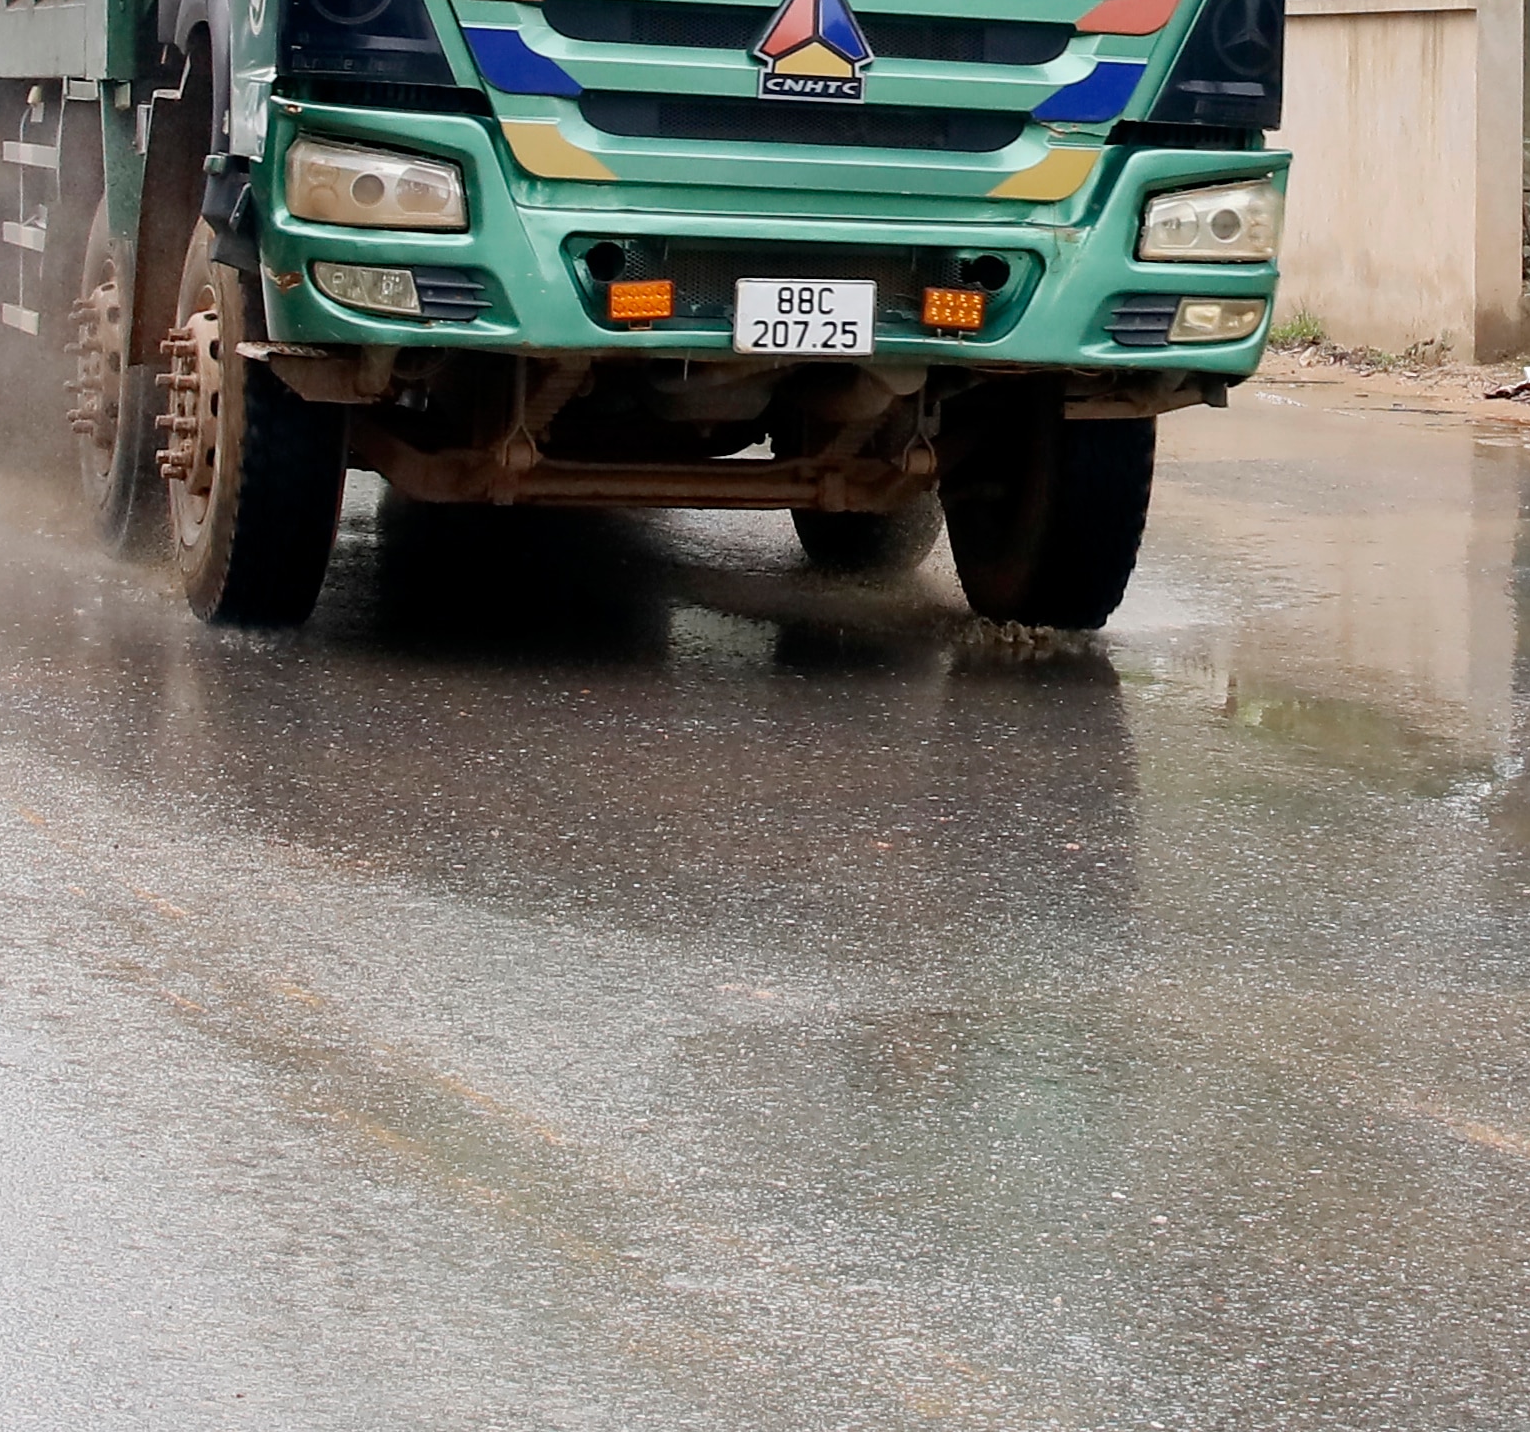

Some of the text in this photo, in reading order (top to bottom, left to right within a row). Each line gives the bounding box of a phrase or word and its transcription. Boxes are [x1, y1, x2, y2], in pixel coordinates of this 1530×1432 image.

[765, 78, 860, 96] CNHTC
[777, 286, 836, 316] 88C
[751, 320, 859, 350] 207.25
